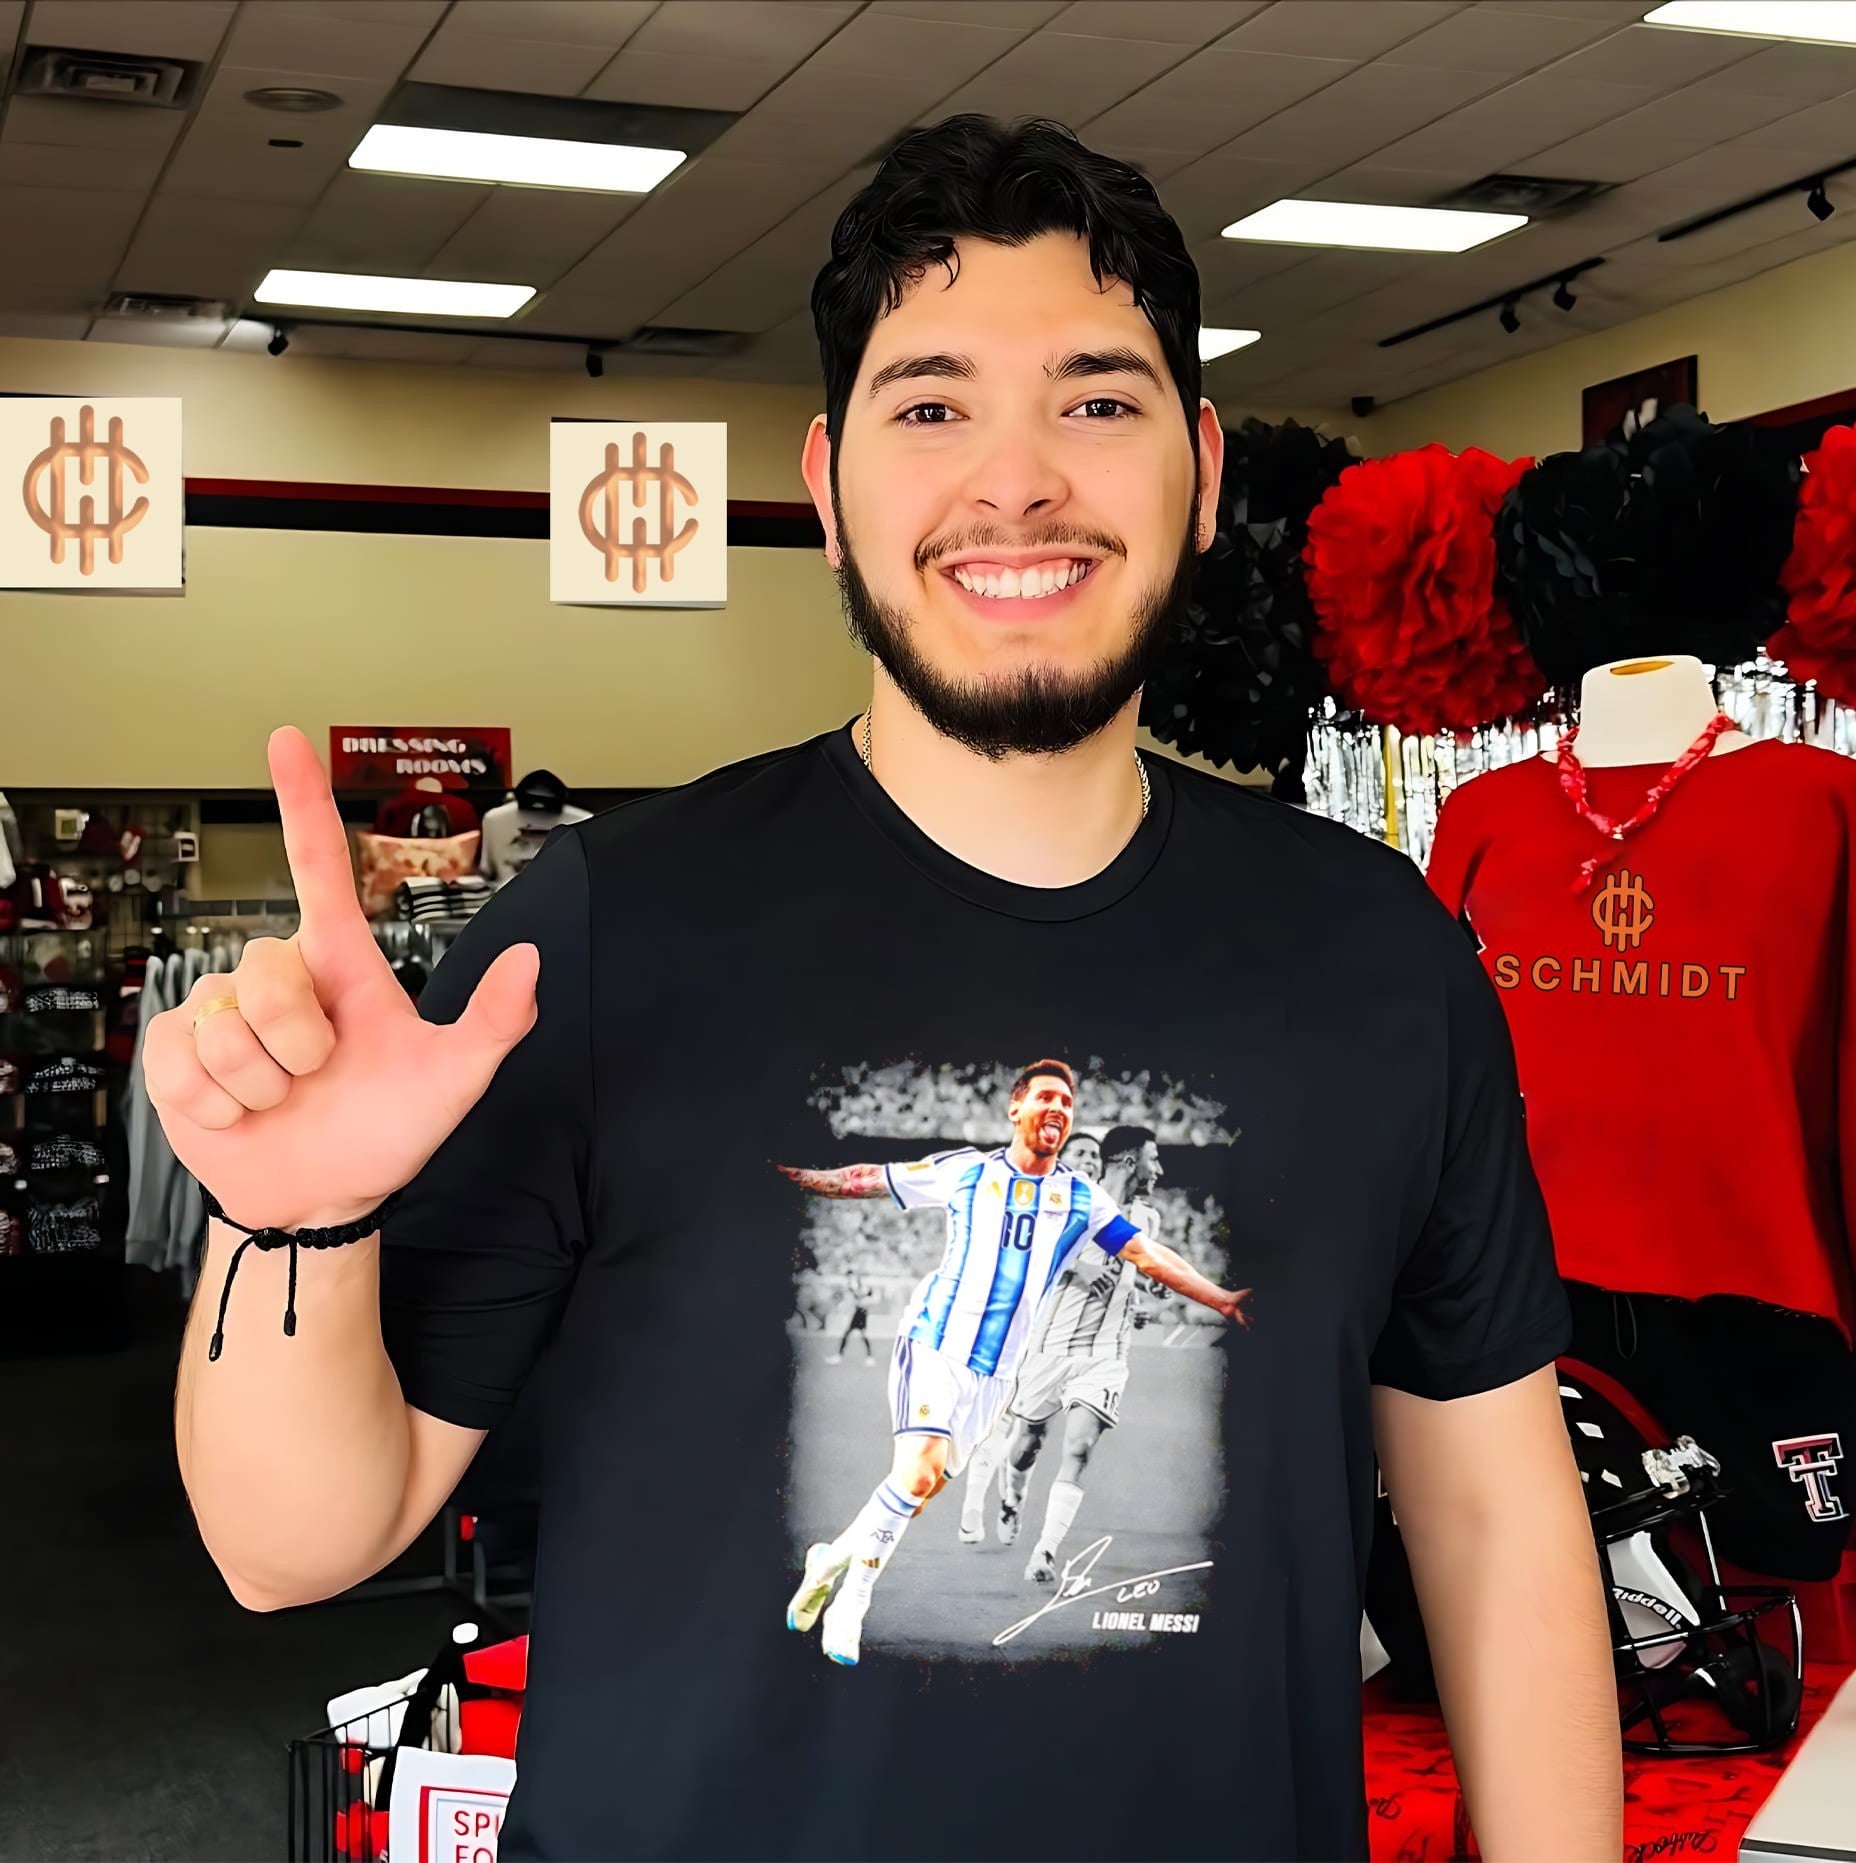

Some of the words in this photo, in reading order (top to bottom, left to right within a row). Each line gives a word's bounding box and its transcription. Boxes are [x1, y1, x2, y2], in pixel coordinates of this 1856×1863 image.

[396, 758, 487, 775] ROOMS
[1494, 953, 1747, 1000] SCHMIDT
[1091, 1611, 1147, 1631] LIONEL
[1149, 1612, 1200, 1633] MESSI
